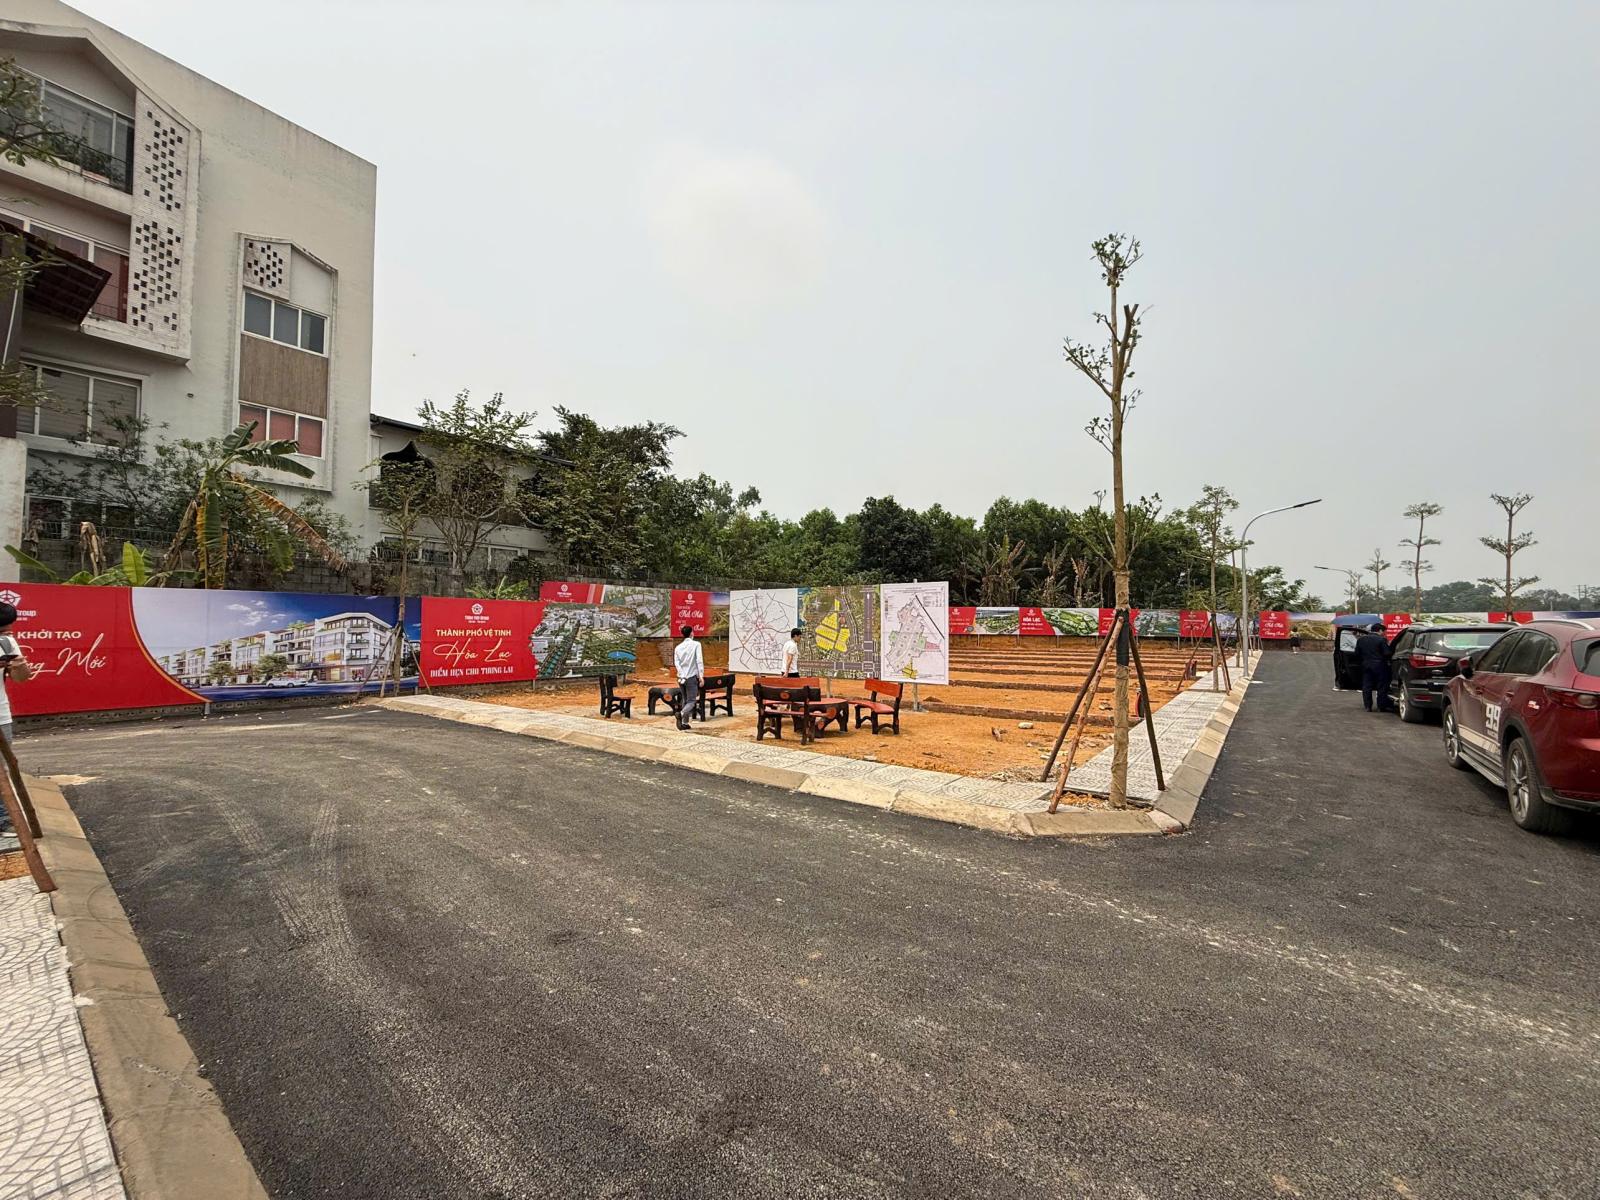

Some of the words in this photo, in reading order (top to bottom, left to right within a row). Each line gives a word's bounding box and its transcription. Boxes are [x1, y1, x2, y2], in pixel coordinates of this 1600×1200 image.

[17, 629, 52, 640] KHỞI
[55, 631, 81, 641] TẠO
[435, 628, 465, 637] THÀNH
[466, 628, 483, 637] PHỐ
[483, 628, 494, 638] VỆ
[493, 629, 512, 637] TINH
[56, 633, 107, 676] Mới
[433, 637, 479, 668] Hòa
[483, 637, 512, 662] Lạc
[430, 666, 448, 678] ĐIỂM
[503, 666, 514, 674] LAI
[1486, 703, 1501, 732] 99
